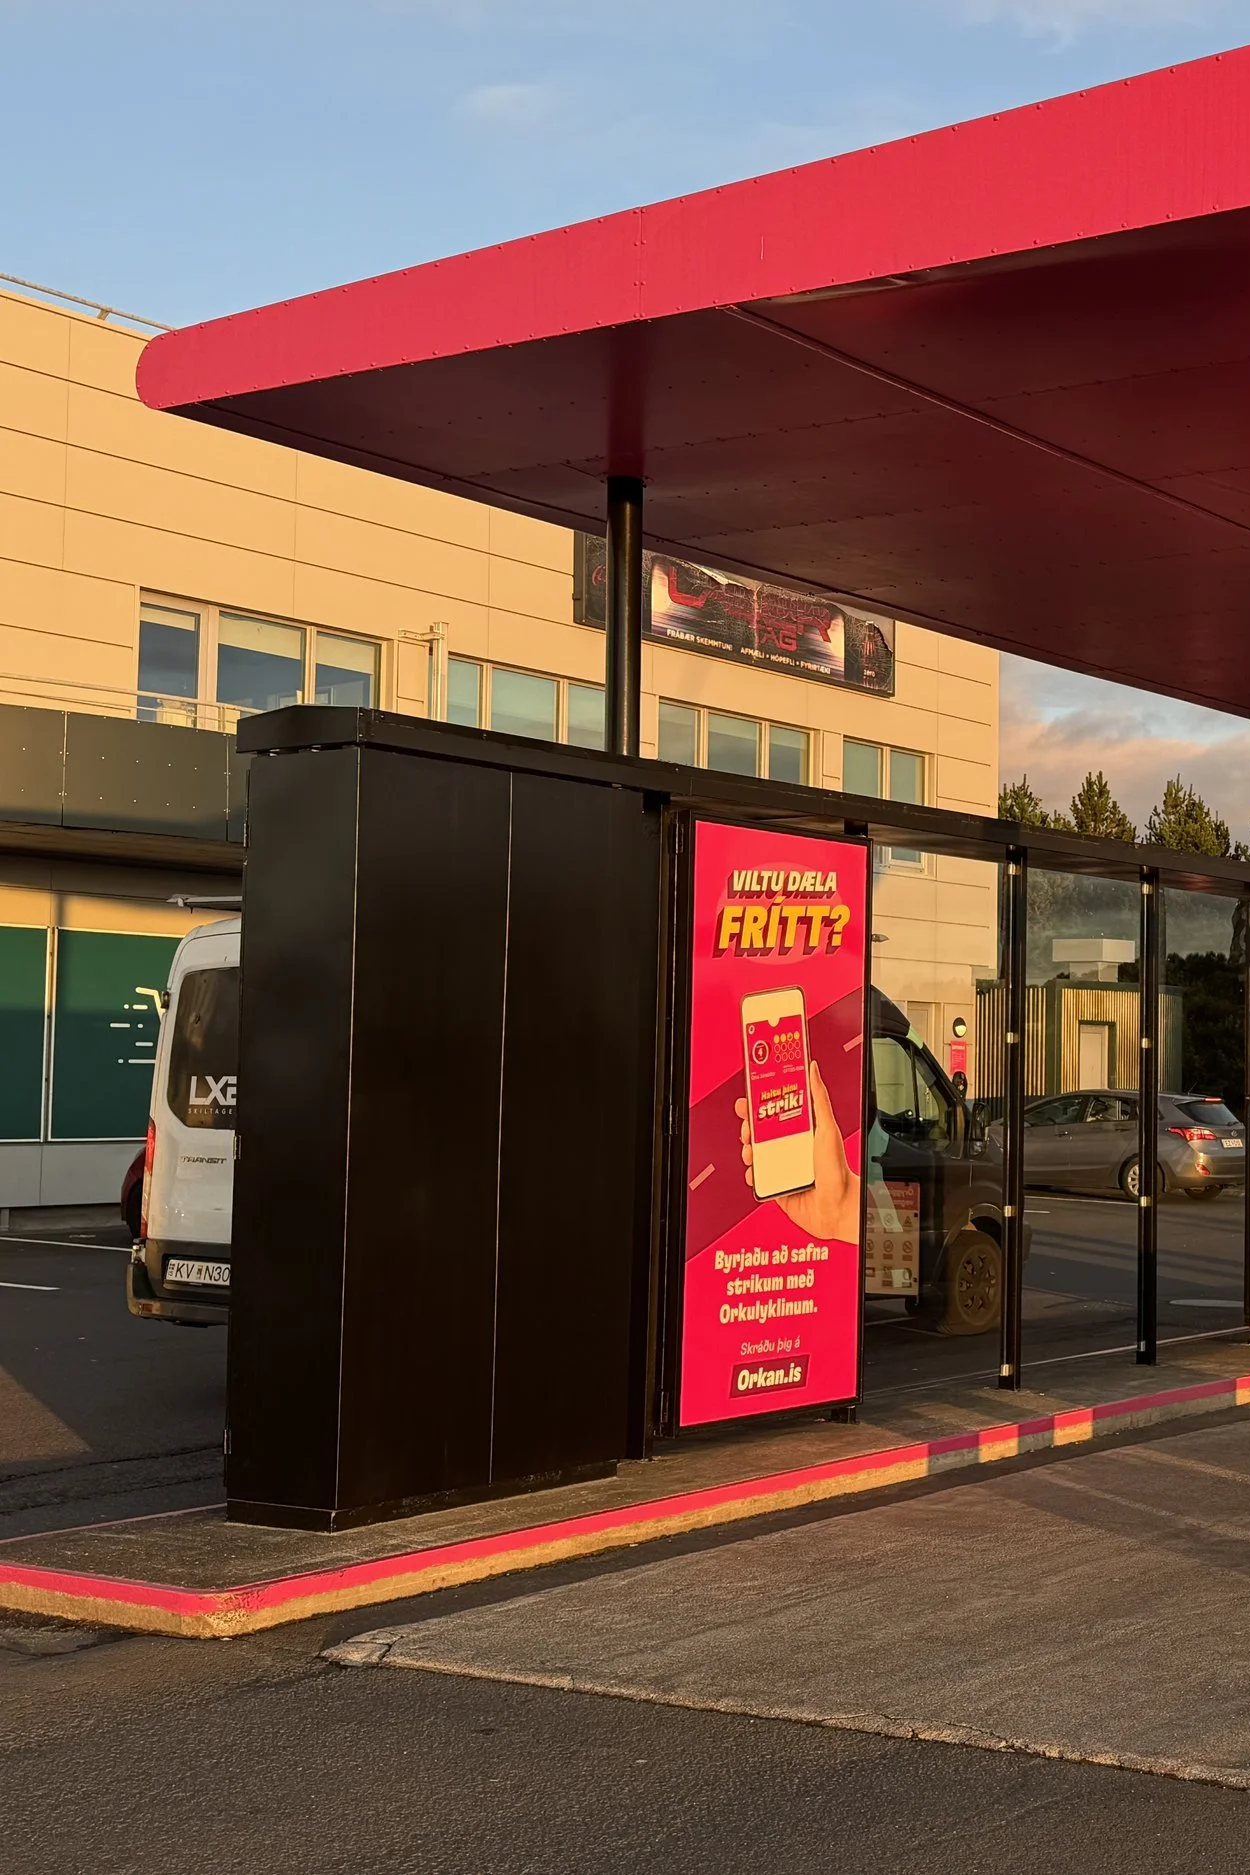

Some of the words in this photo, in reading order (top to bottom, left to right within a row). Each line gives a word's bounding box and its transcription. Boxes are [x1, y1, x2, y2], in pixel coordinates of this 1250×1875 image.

[731, 870, 785, 893] VILTU
[786, 871, 837, 893] DÆLA
[717, 895, 851, 950] FRÍTT?
[758, 1090, 804, 1119] striki
[181, 1155, 227, 1165] TRANSIT
[174, 1262, 195, 1279] KV
[714, 1247, 769, 1274] Byrjaðu
[772, 1244, 789, 1265] að
[791, 1242, 829, 1263] safna
[726, 1273, 784, 1297] strikum
[786, 1268, 815, 1290] með
[719, 1297, 818, 1324] Orkulyklinum.
[740, 1337, 775, 1356] Skráðu
[777, 1337, 792, 1353] þig
[794, 1335, 801, 1349] á
[737, 1362, 803, 1391] Orkan.is
